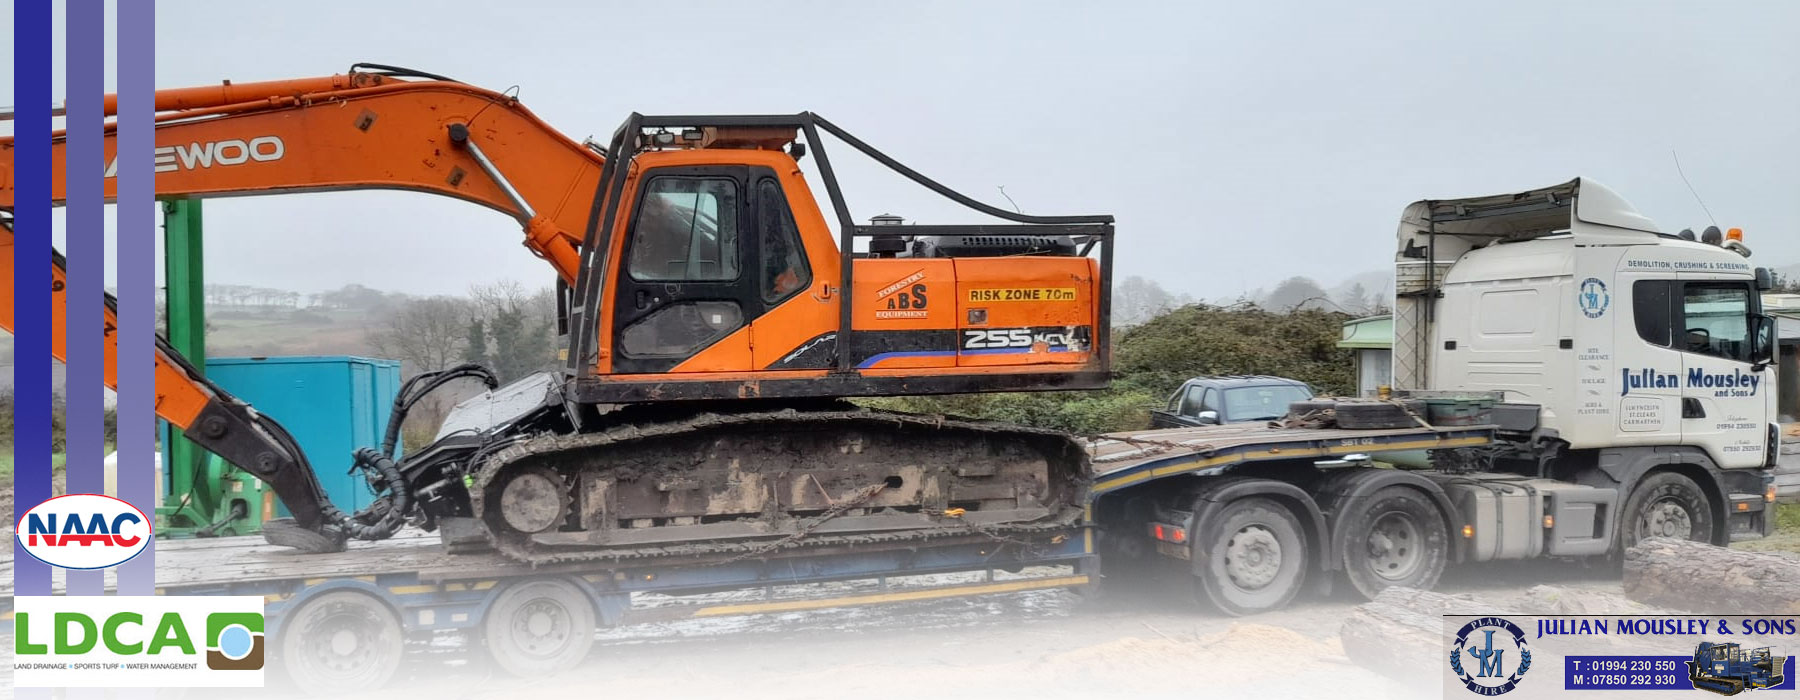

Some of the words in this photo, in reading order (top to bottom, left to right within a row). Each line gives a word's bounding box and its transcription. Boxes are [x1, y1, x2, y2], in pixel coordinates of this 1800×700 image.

[104, 136, 285, 178] EWOO
[1628, 260, 1673, 269] DEMOLITION,
[1716, 262, 1750, 270] SCREENING
[877, 271, 924, 298] FORESTRY
[887, 283, 928, 310] ABS
[971, 289, 1000, 300] RISK
[1005, 289, 1041, 300] ZONE
[1046, 289, 1074, 300] 70m
[876, 311, 928, 319] EQUIPMENT
[965, 329, 1032, 348] 255
[1621, 368, 1679, 397] Julian
[1687, 368, 1760, 397] Mousley
[1714, 389, 1729, 397] and
[1731, 389, 1748, 397] Sons
